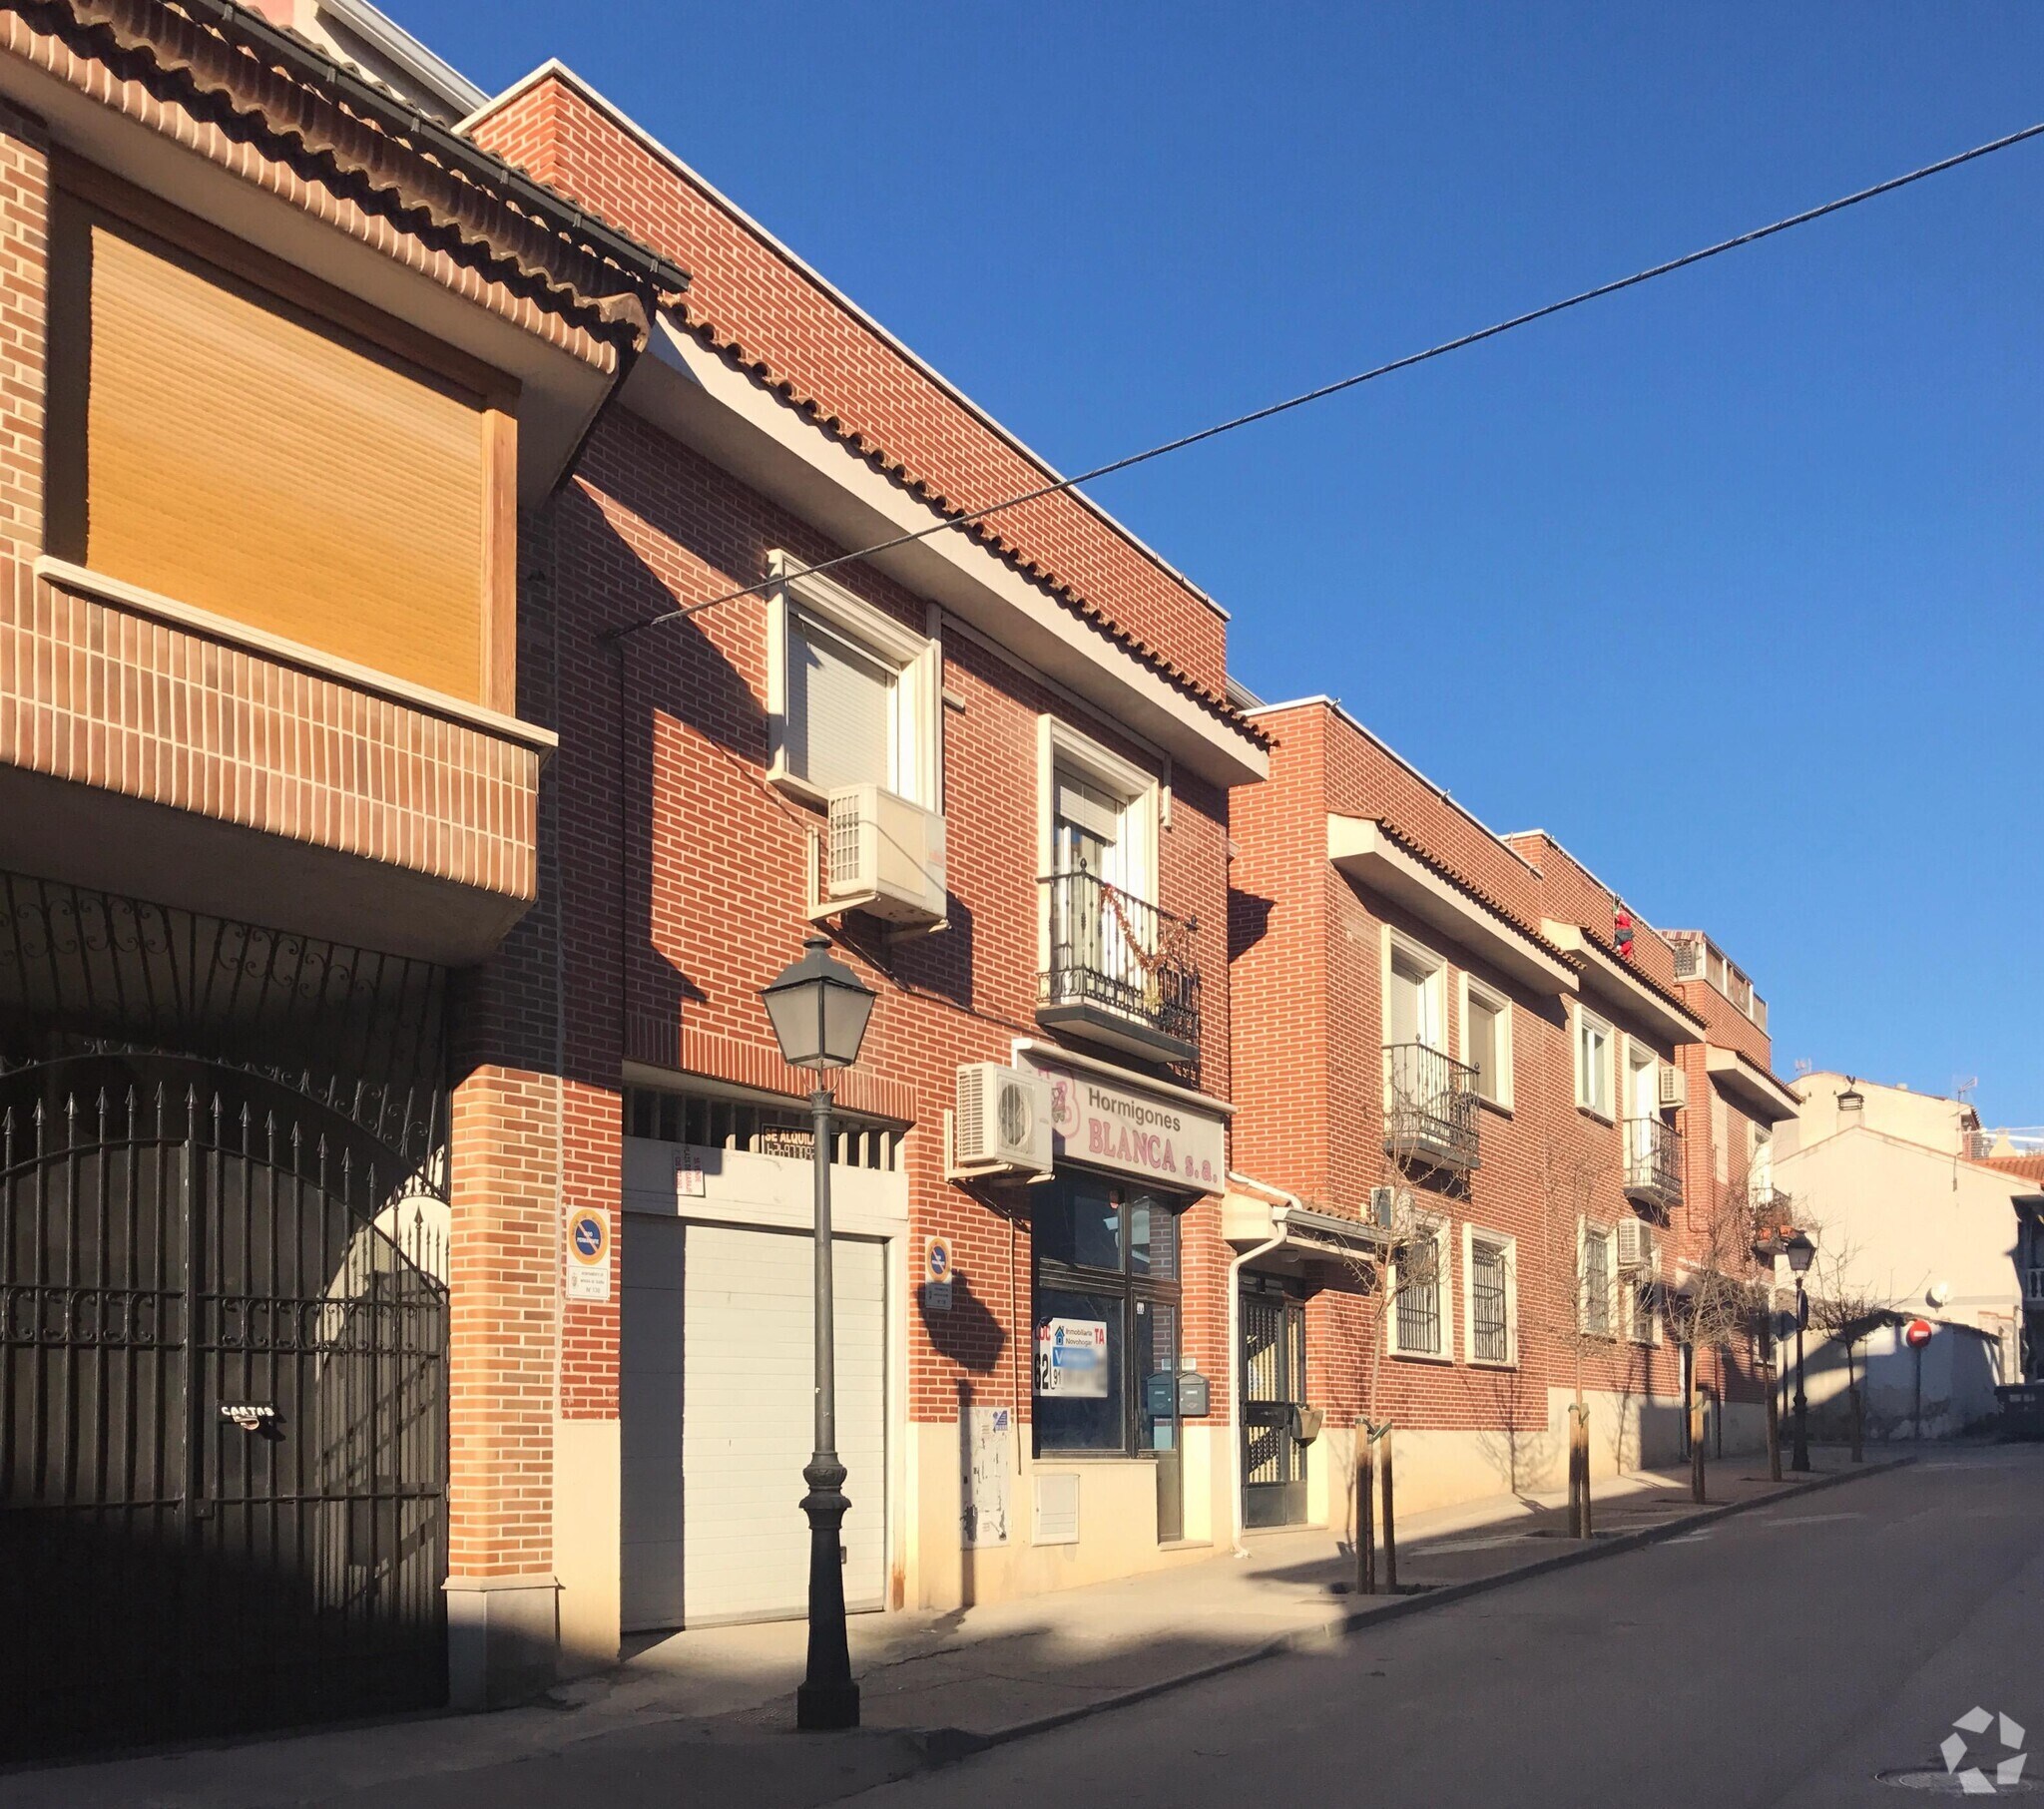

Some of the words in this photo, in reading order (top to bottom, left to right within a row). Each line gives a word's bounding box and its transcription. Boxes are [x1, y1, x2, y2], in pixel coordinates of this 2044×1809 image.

[1088, 1087, 1182, 1132] Hormigones
[765, 1128, 778, 1142] SE
[1088, 1118, 1176, 1172] BLANCA
[1065, 1338, 1093, 1347] Novohogar
[1094, 1328, 1105, 1345] TA
[1034, 1353, 1056, 1390] 62
[221, 1406, 275, 1417] CARTAS
